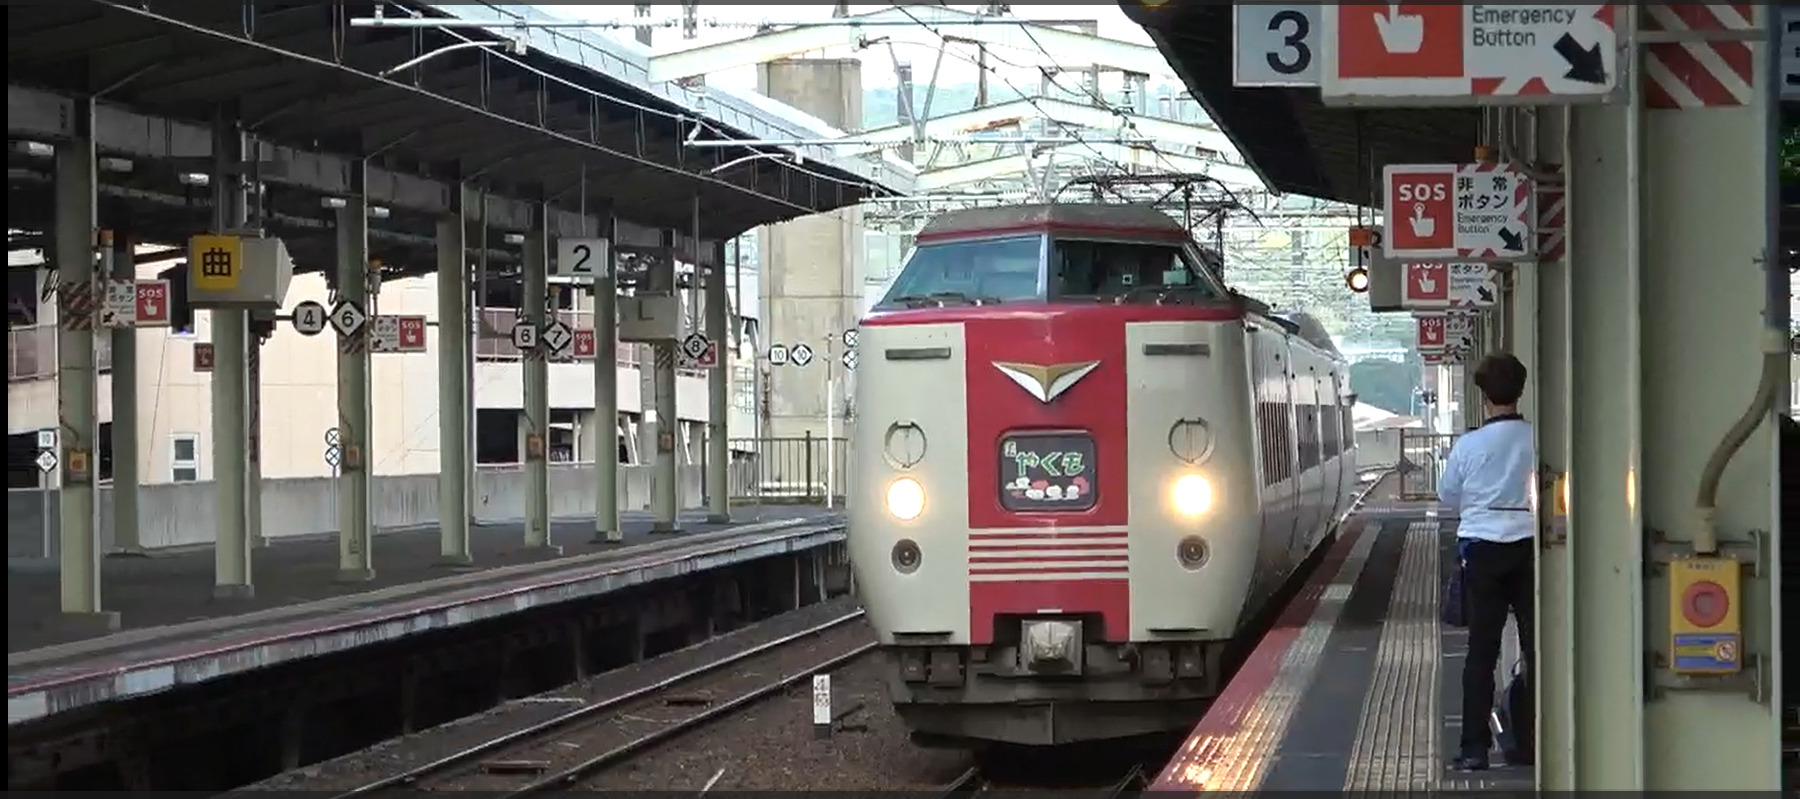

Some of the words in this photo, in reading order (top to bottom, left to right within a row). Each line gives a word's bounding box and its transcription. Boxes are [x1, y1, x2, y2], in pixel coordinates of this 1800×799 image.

[1472, 6, 1577, 25] Emergency
[1266, 10, 1311, 74] 3
[1472, 28, 1536, 46] Button
[1457, 177, 1508, 191] 非常
[1399, 183, 1446, 201] SOS
[1458, 194, 1508, 209] ボタン
[1458, 213, 1508, 224] Emergency
[1458, 225, 1490, 233] Button
[573, 245, 591, 272] 2
[139, 289, 163, 299] SOS
[303, 310, 315, 327] 4
[341, 311, 354, 328] 6
[401, 321, 421, 329] SOS
[1422, 319, 1441, 327] SOS
[521, 329, 530, 343] 6
[552, 331, 561, 344] 7
[691, 340, 700, 353] 8
[774, 350, 784, 360] 10
[1015, 452, 1084, 476] やくも
